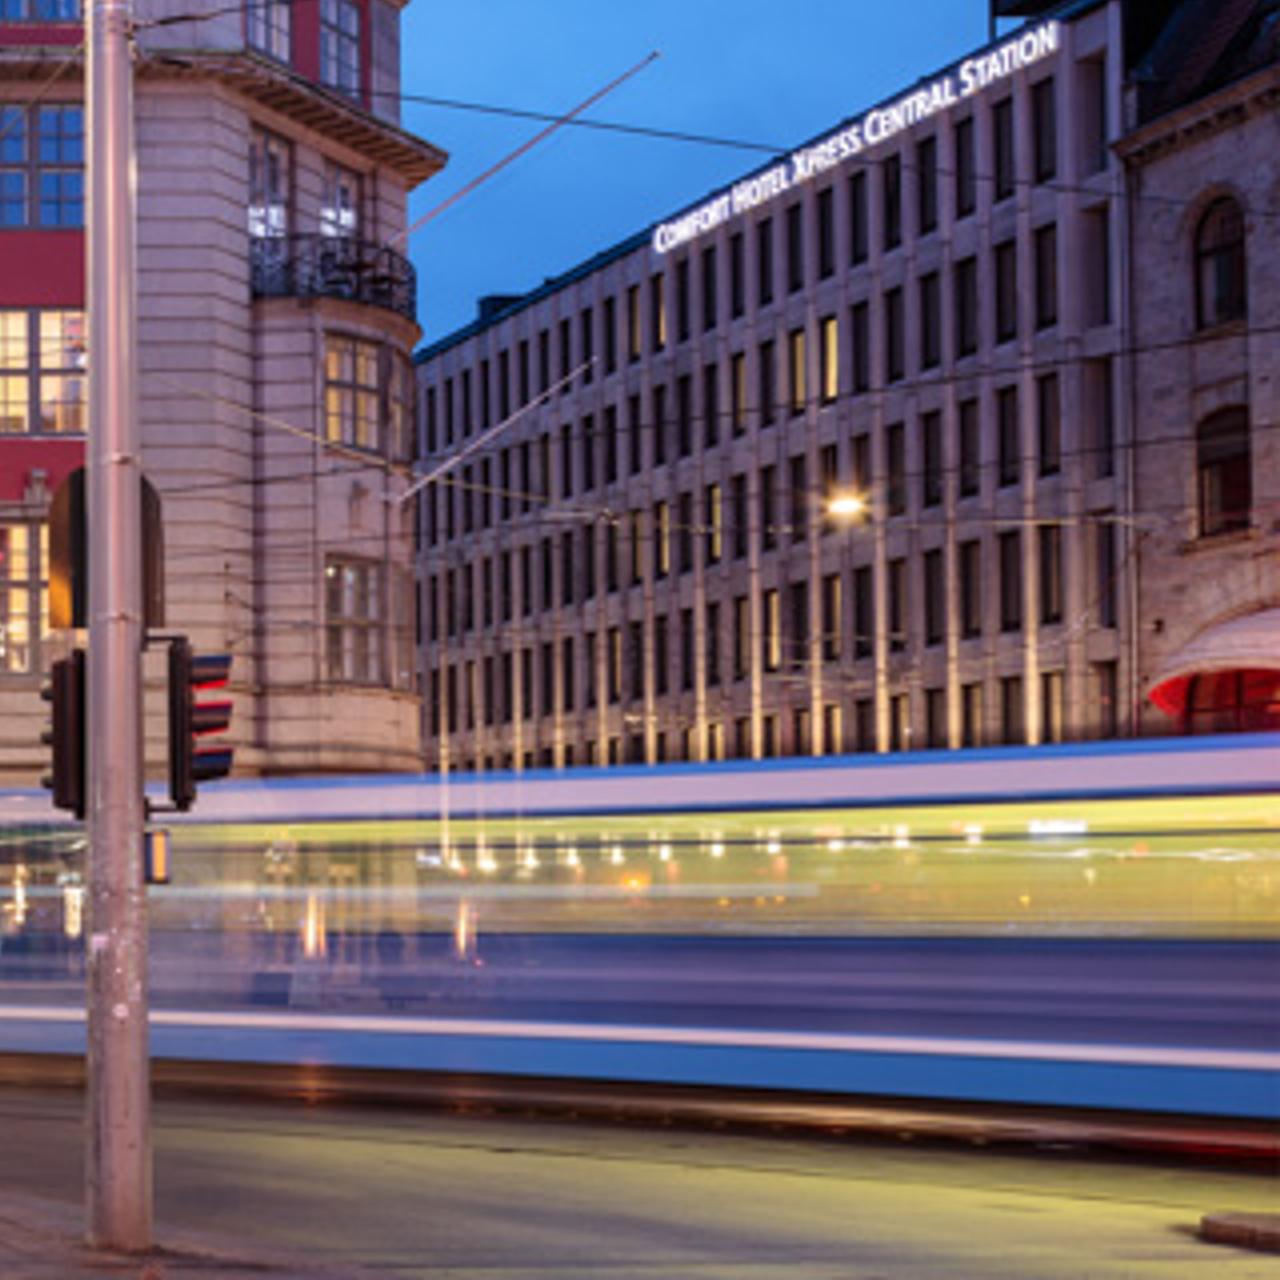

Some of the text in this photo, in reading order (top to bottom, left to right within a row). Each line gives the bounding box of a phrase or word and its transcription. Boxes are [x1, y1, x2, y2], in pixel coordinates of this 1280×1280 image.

[731, 164, 790, 214] HOTEL
[792, 124, 862, 184] XPRESS
[864, 77, 958, 144] CENTRAL
[959, 21, 1058, 98] STATION
